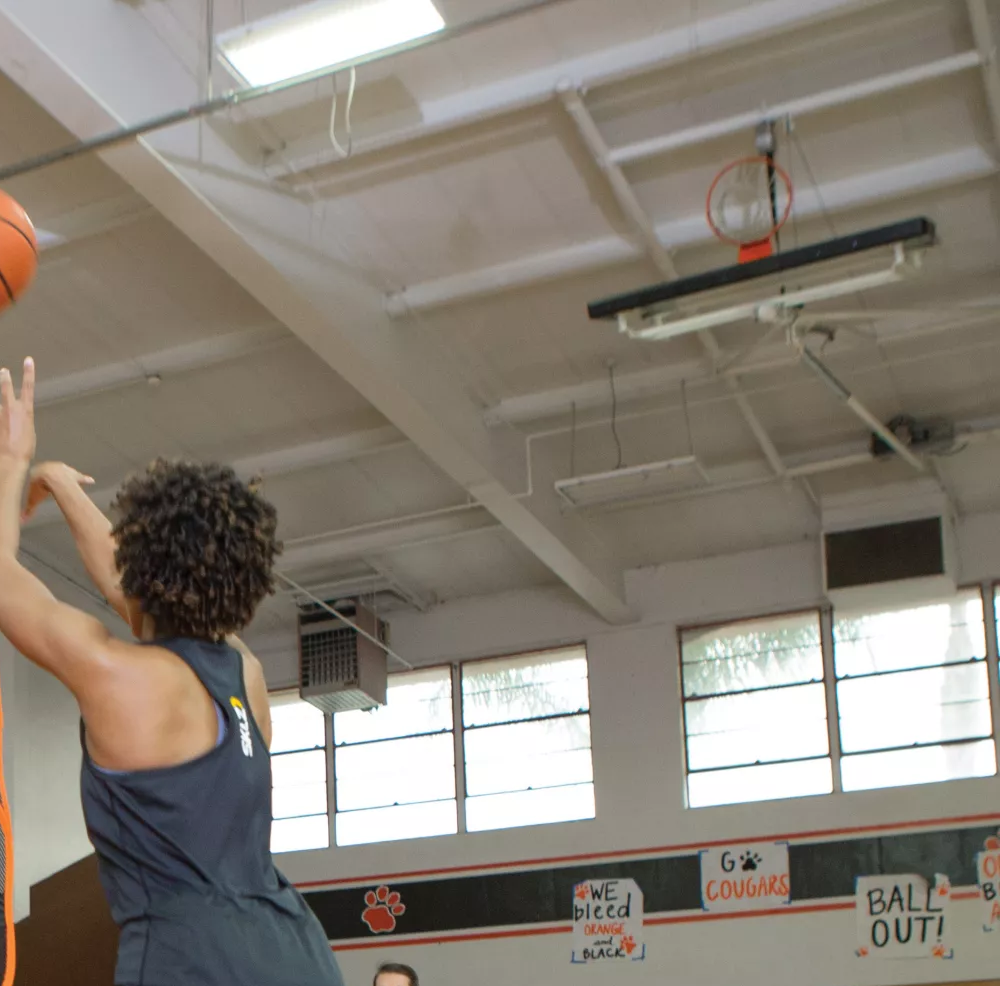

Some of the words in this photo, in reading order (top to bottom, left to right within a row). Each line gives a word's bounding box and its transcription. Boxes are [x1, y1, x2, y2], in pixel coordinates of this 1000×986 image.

[590, 881, 618, 900] WE
[706, 874, 789, 902] COUGARS
[867, 882, 943, 916] BALL
[574, 892, 631, 922] bleed
[584, 922, 624, 936] ORANGE
[871, 915, 943, 948] OUT!
[583, 947, 625, 960] BLACK
